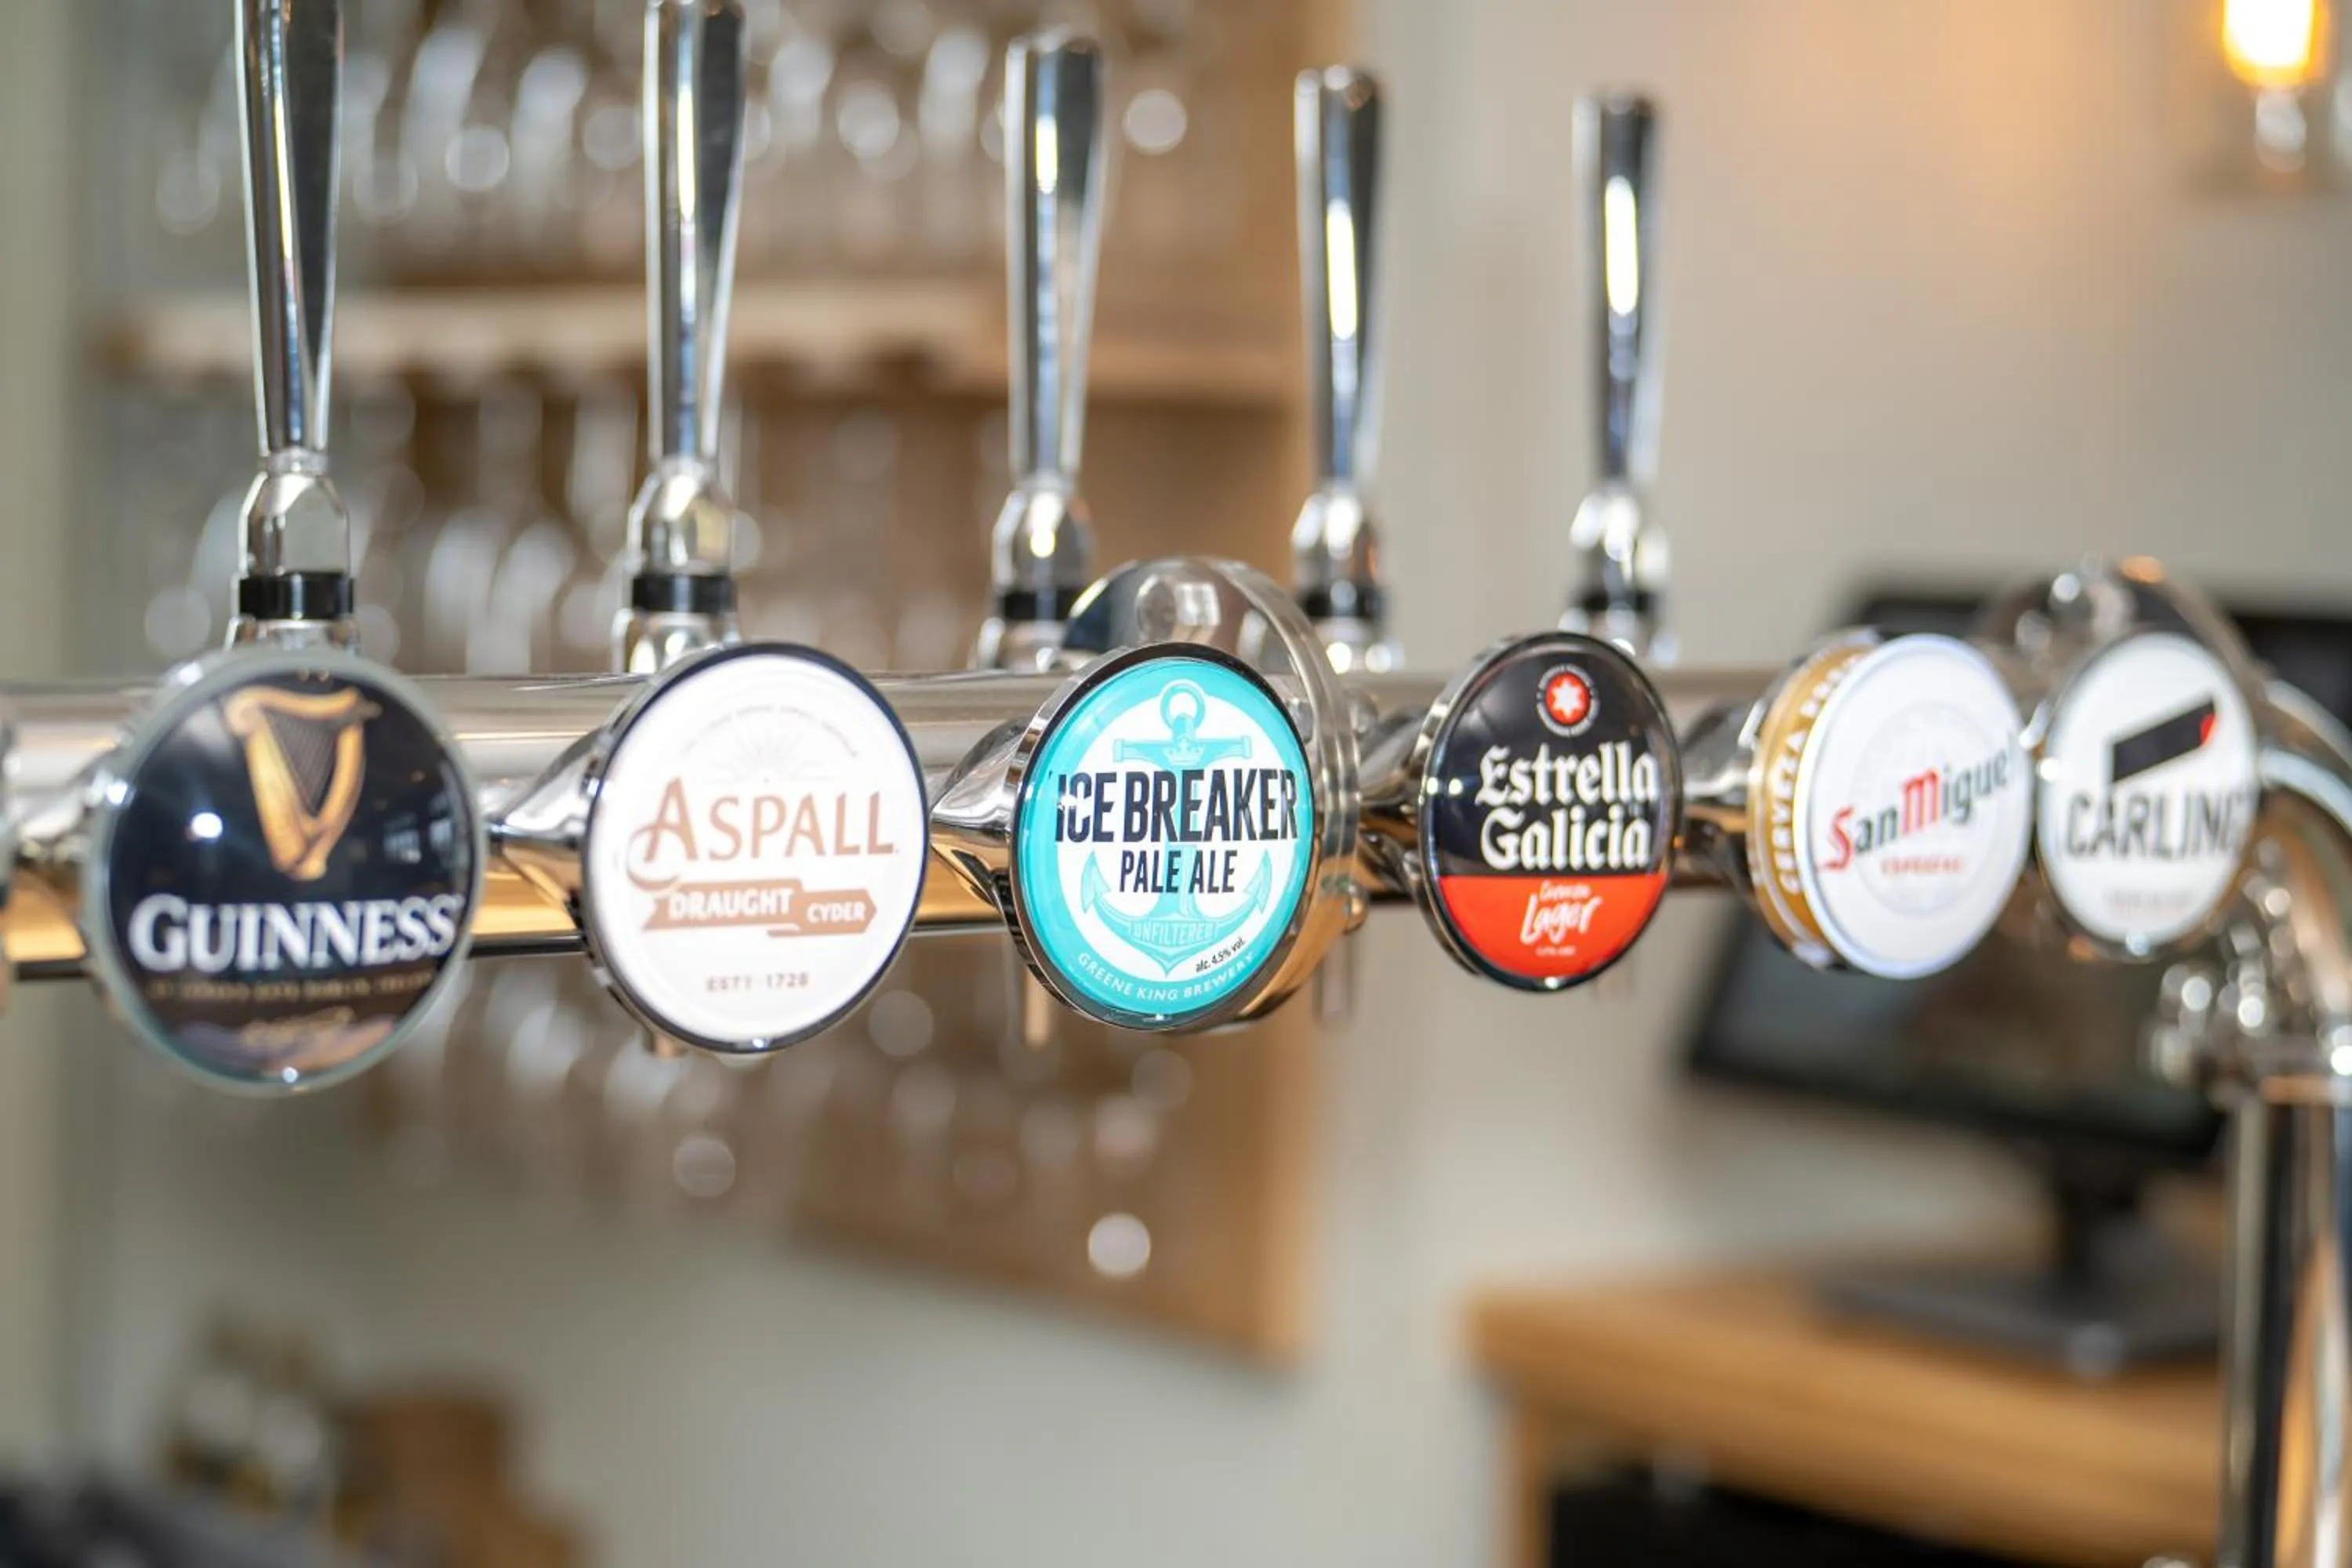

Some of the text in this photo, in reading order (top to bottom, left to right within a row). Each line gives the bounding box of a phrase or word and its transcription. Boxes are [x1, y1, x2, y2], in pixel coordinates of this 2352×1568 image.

[1475, 740, 1661, 807] Estrella
[1054, 768, 1298, 844] ICE BREAKER
[626, 777, 895, 891] ASPALL
[1480, 805, 1653, 871] Galicia
[1119, 849, 1238, 894] PALE ALE
[668, 888, 793, 921] DRAUGHT
[807, 902, 867, 923] CYDER
[1519, 893, 1602, 945] Lager
[127, 892, 463, 973] GUINNESS
[1134, 921, 1214, 946] UNFILTERED
[1077, 952, 1256, 1000] GREENE KING BREWERY
